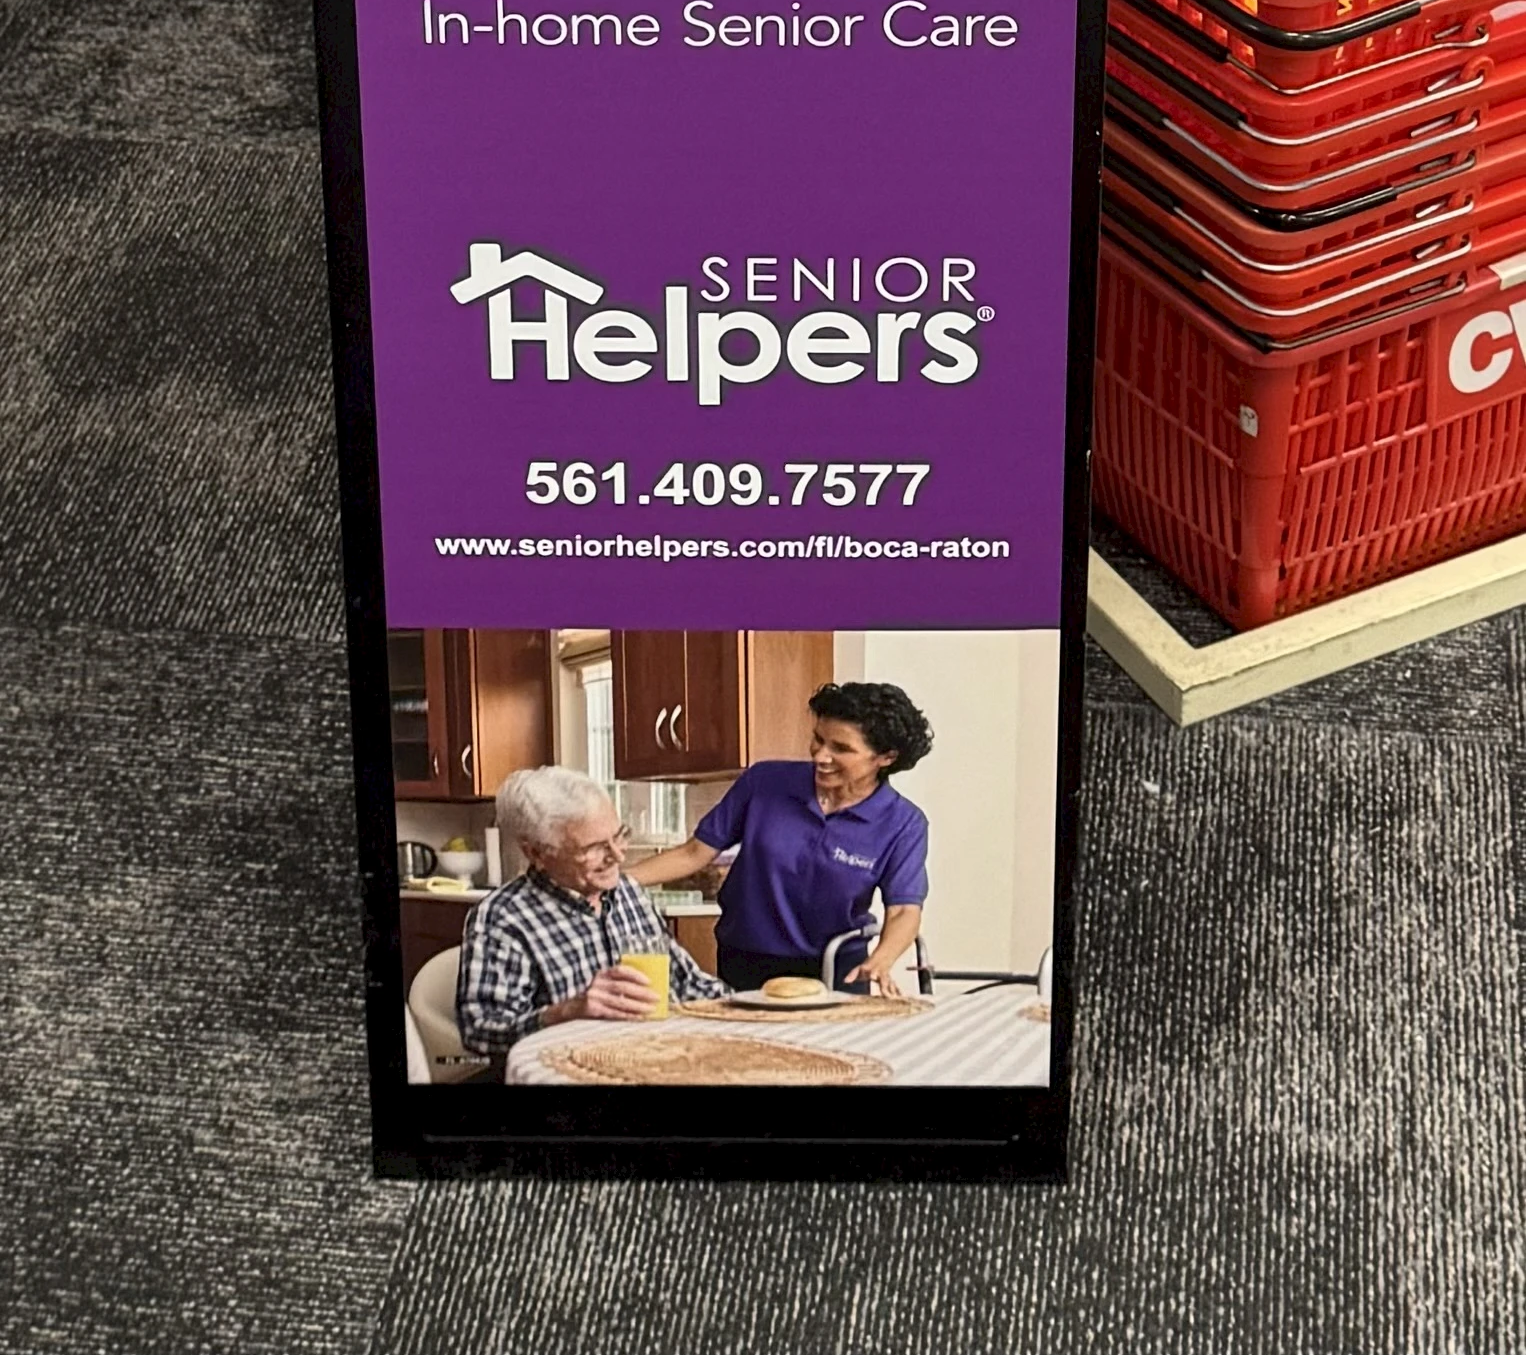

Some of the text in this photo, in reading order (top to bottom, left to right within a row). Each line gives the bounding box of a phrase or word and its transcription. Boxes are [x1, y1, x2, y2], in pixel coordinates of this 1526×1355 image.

[683, 0, 864, 47] Senior
[882, 0, 1018, 47] Care
[700, 256, 977, 303] SENIOR
[525, 461, 931, 506] 561.409.7577
[434, 534, 1010, 563] www.seniorhelpers.com/fl/boca-raton
